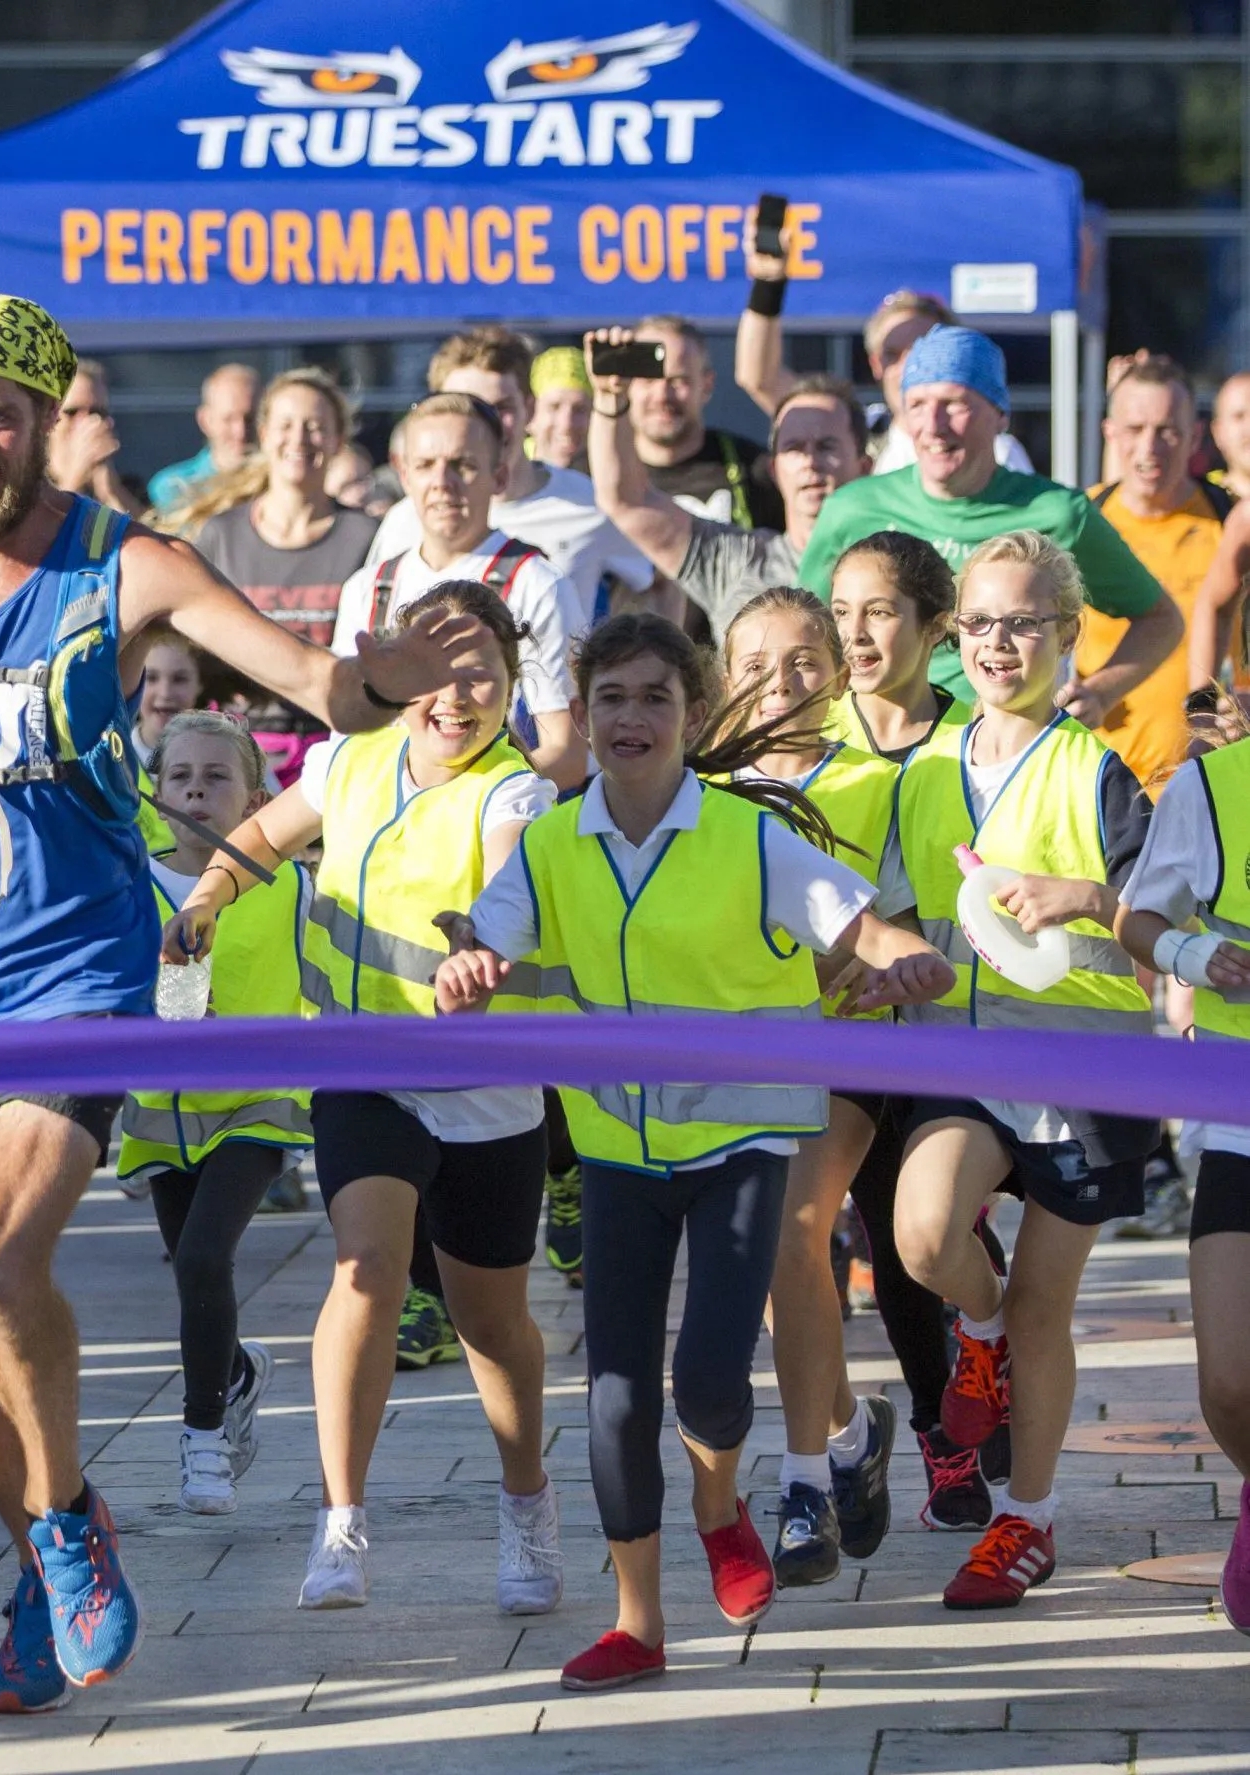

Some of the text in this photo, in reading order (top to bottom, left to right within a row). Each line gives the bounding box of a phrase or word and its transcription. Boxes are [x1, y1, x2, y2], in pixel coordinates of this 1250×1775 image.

[178, 100, 724, 170] TRUESTART
[61, 203, 824, 285] PERFORMANCE COFFE
